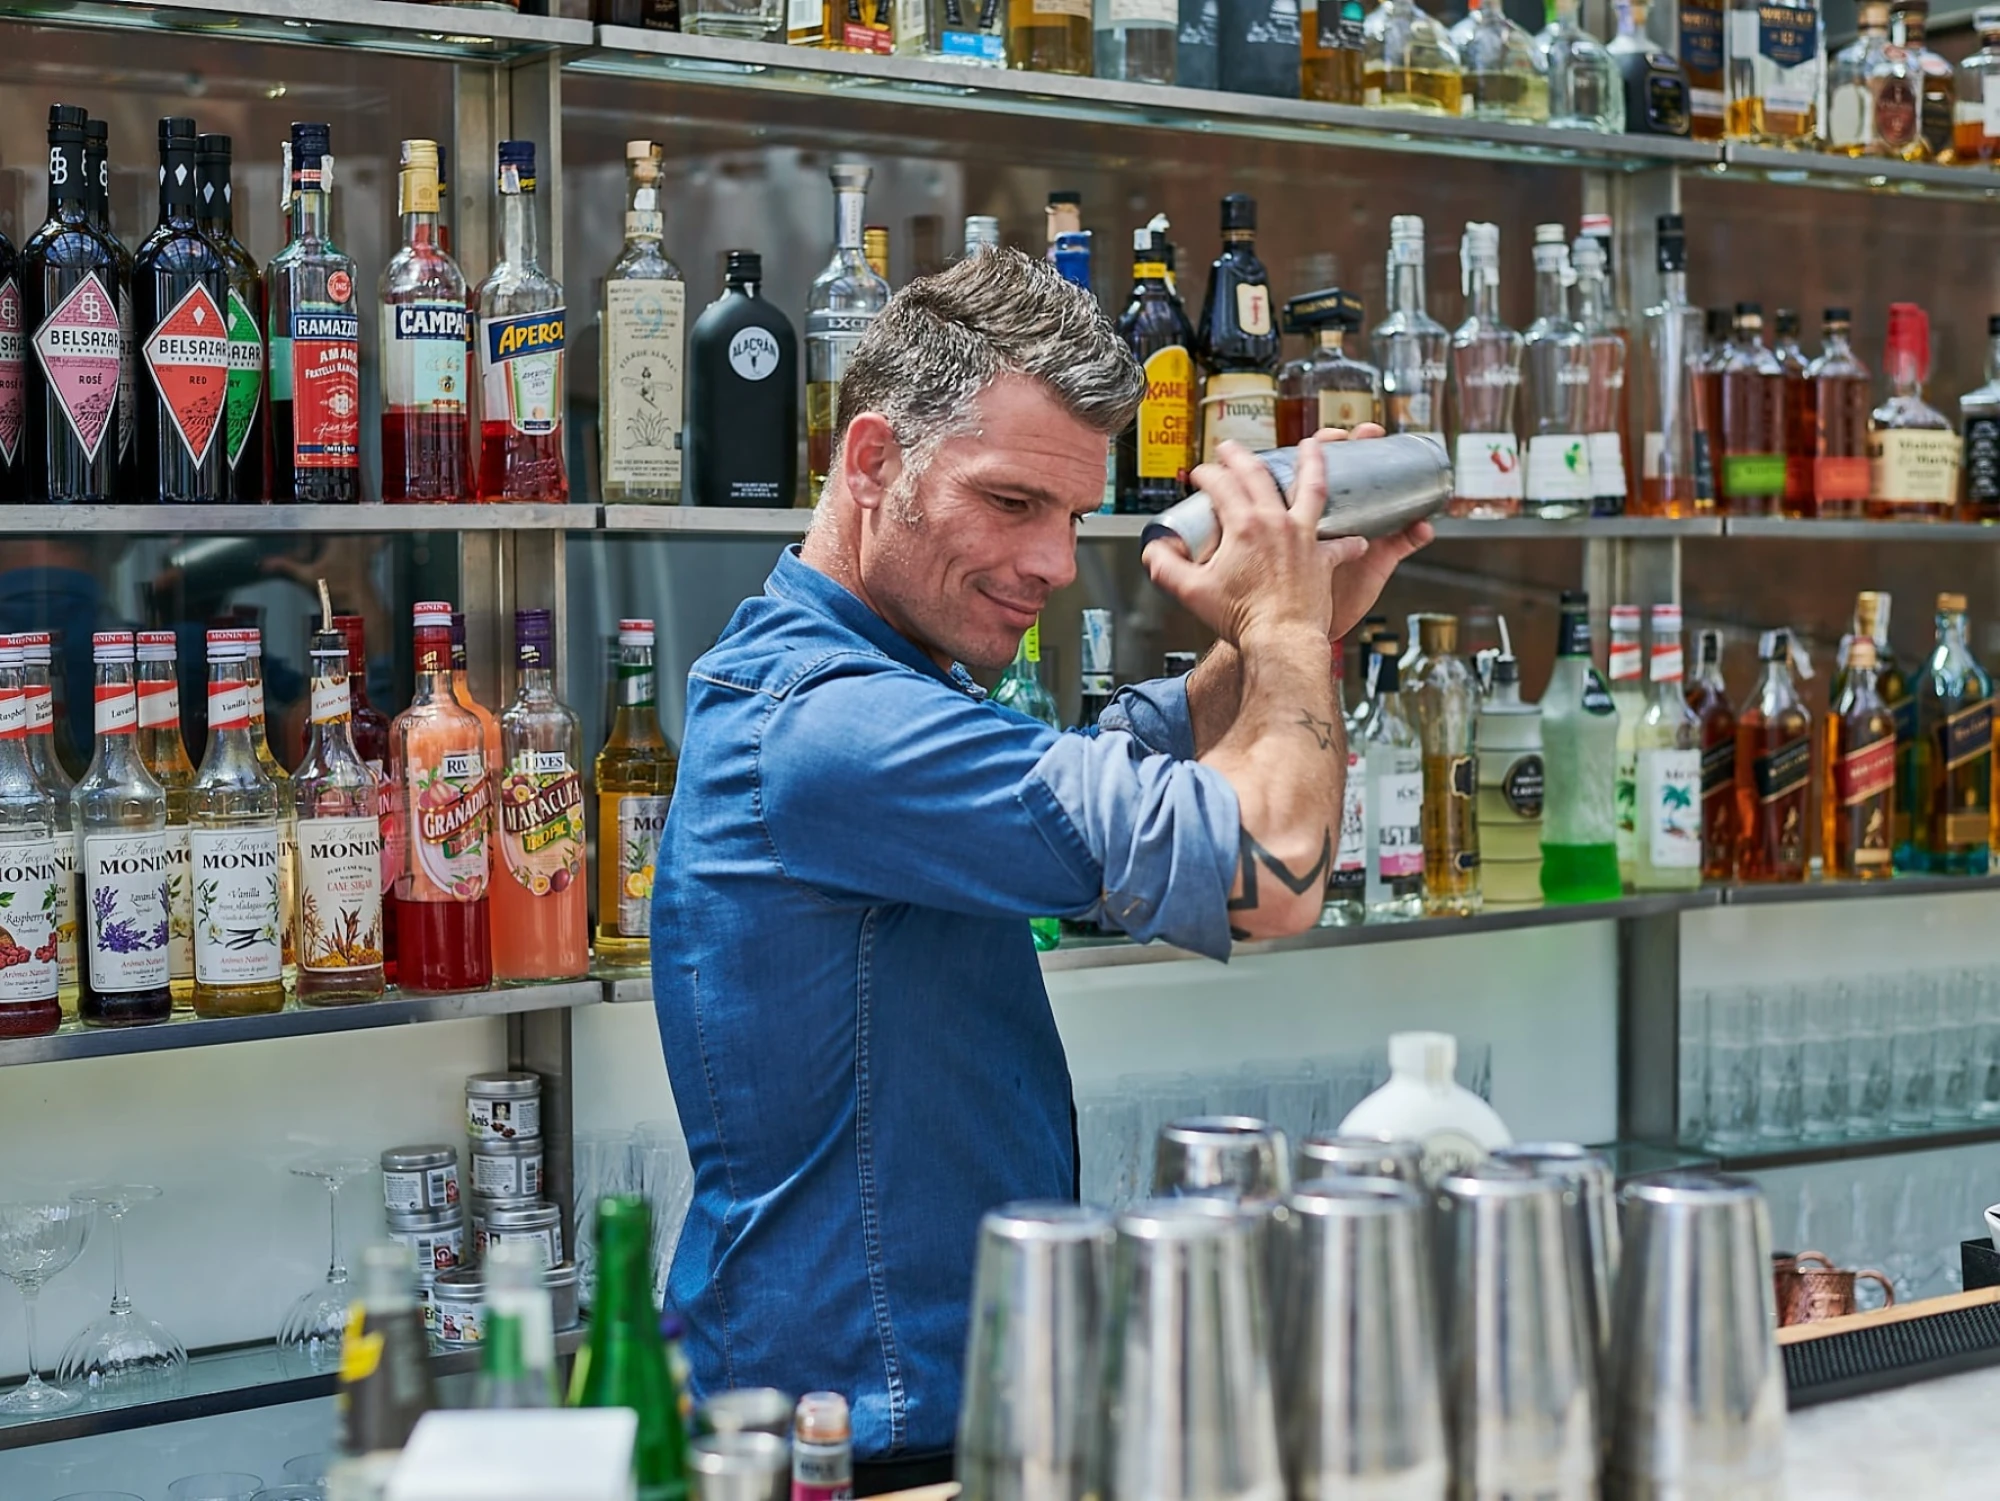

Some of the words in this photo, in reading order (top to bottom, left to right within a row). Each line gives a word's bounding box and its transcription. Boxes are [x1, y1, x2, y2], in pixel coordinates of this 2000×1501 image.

[298, 320, 358, 337] RAMAZZO
[400, 310, 466, 334] CAMPA
[828, 318, 871, 329] EXCE
[498, 321, 564, 355] APEROL
[228, 346, 261, 361] AZAR
[79, 373, 102, 385] ROSÉ
[189, 376, 207, 385] RED
[229, 380, 241, 388] RY
[211, 632, 242, 640] MONIN
[111, 704, 136, 719] Lavand
[222, 699, 247, 712] Vanilla
[423, 788, 490, 839] GRANADIN
[311, 839, 379, 858] MONIN
[100, 855, 167, 876] MONIN
[203, 850, 276, 870] MONIN
[0, 863, 55, 883] ONIN
[228, 886, 260, 899] Vanilla
[327, 882, 347, 891] CANE
[4, 911, 46, 927] Raspberry
[471, 1112, 489, 1127] Anis
